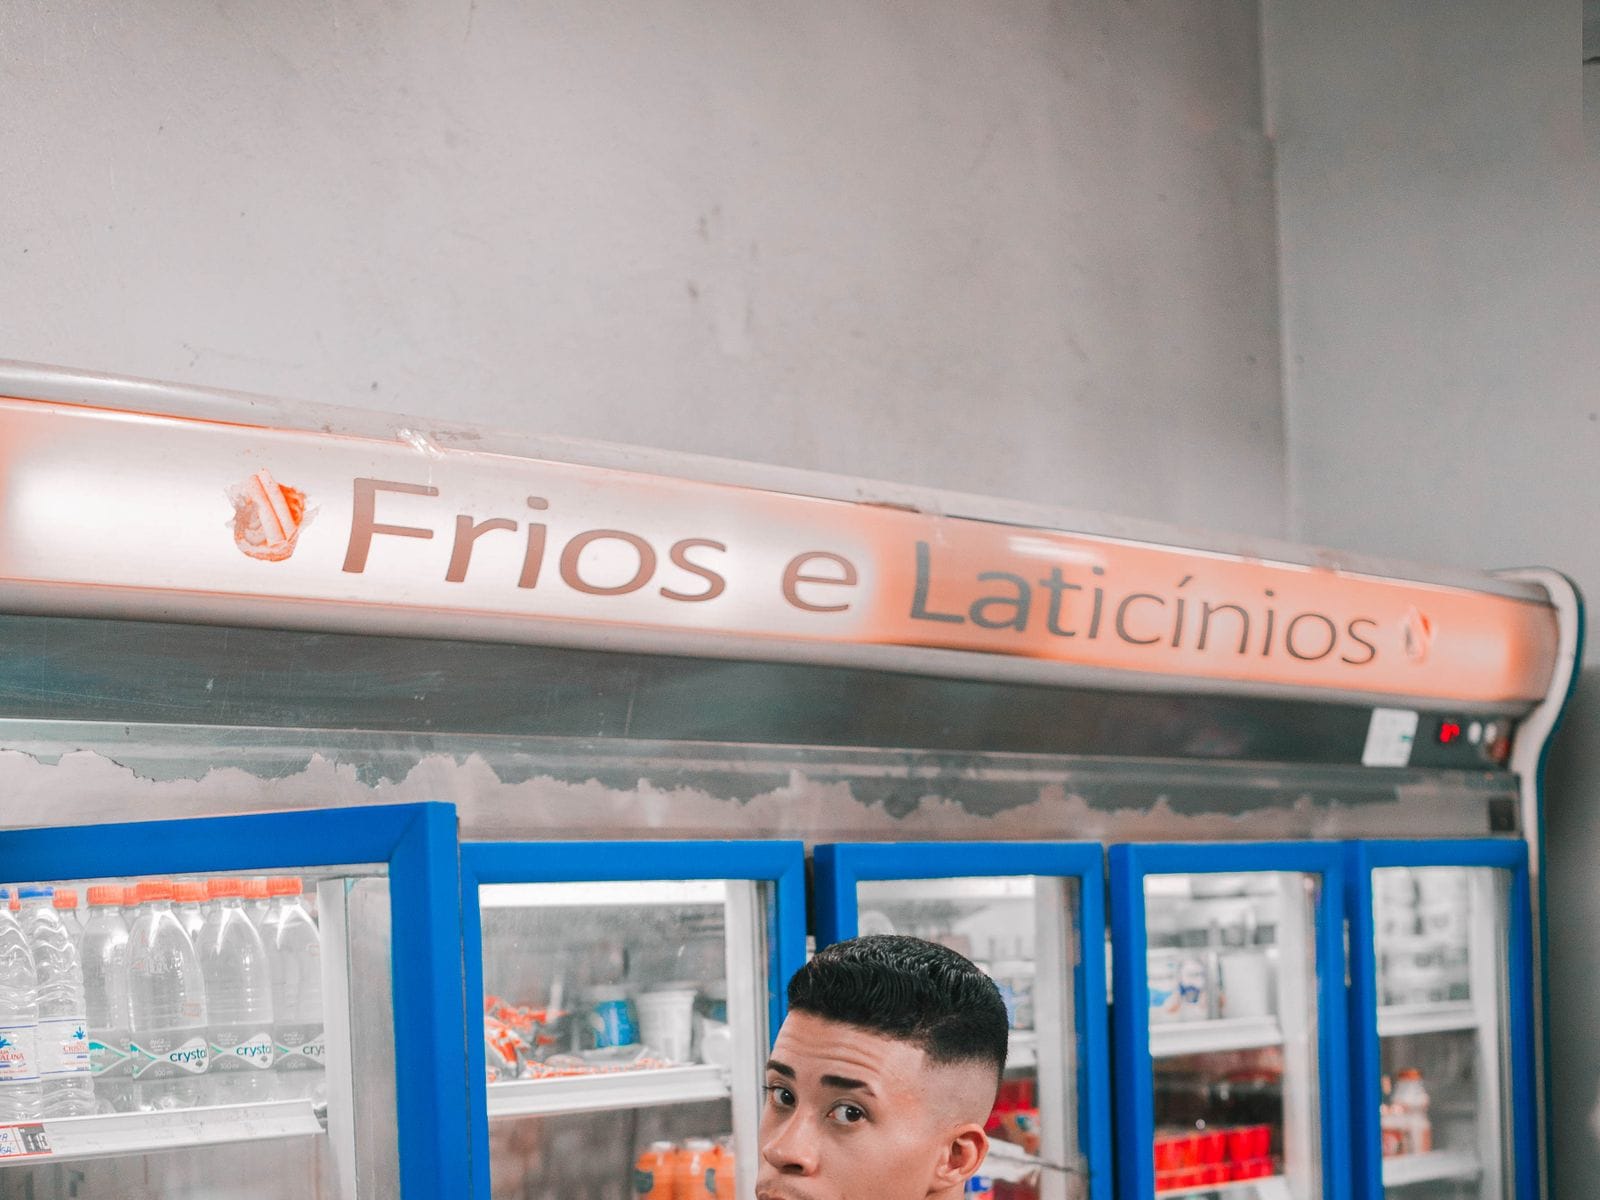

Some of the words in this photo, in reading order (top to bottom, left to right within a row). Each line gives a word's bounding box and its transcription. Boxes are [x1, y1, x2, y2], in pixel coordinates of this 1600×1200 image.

[342, 477, 729, 603] Frios
[781, 550, 859, 613] e
[908, 540, 1378, 666] Laticínios
